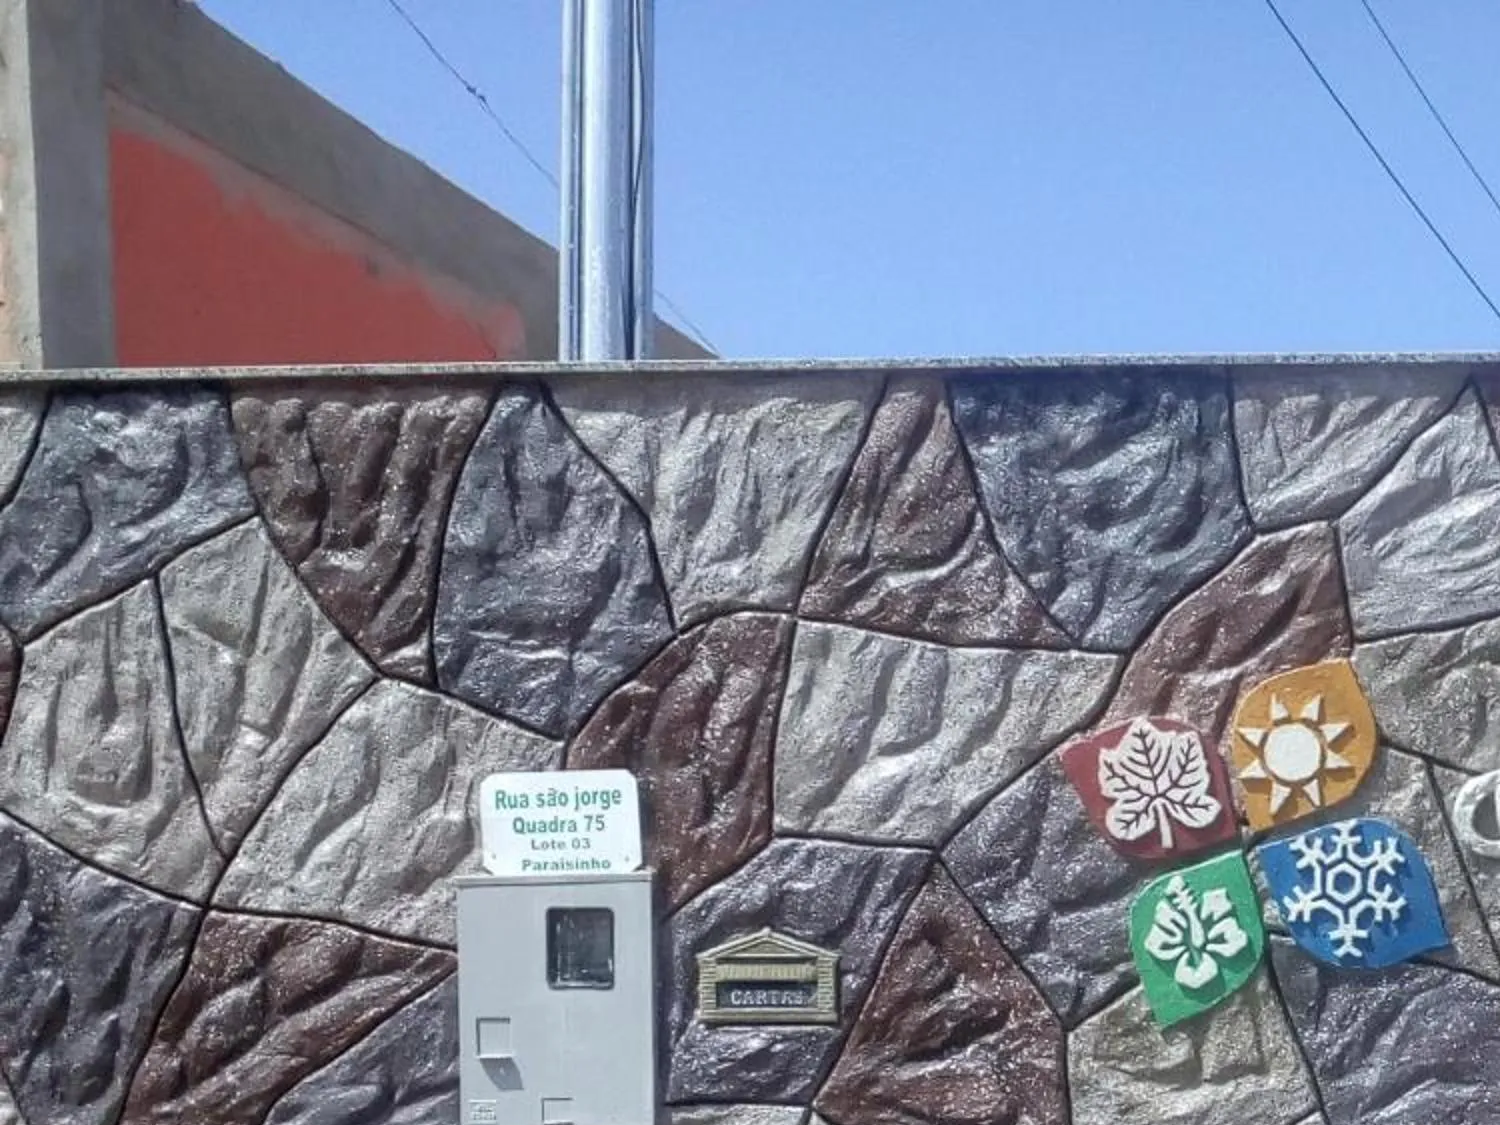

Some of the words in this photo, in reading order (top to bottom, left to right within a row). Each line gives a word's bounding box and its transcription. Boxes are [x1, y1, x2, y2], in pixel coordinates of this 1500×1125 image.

[495, 789, 530, 810] Rua
[536, 788, 569, 808] são
[574, 786, 622, 811] jorge
[512, 816, 578, 834] Quadra
[584, 814, 605, 832] 75
[531, 839, 566, 851] Lote
[571, 838, 591, 850] 03
[521, 857, 612, 872] Paraisinho
[730, 989, 804, 1006] CARTAS
